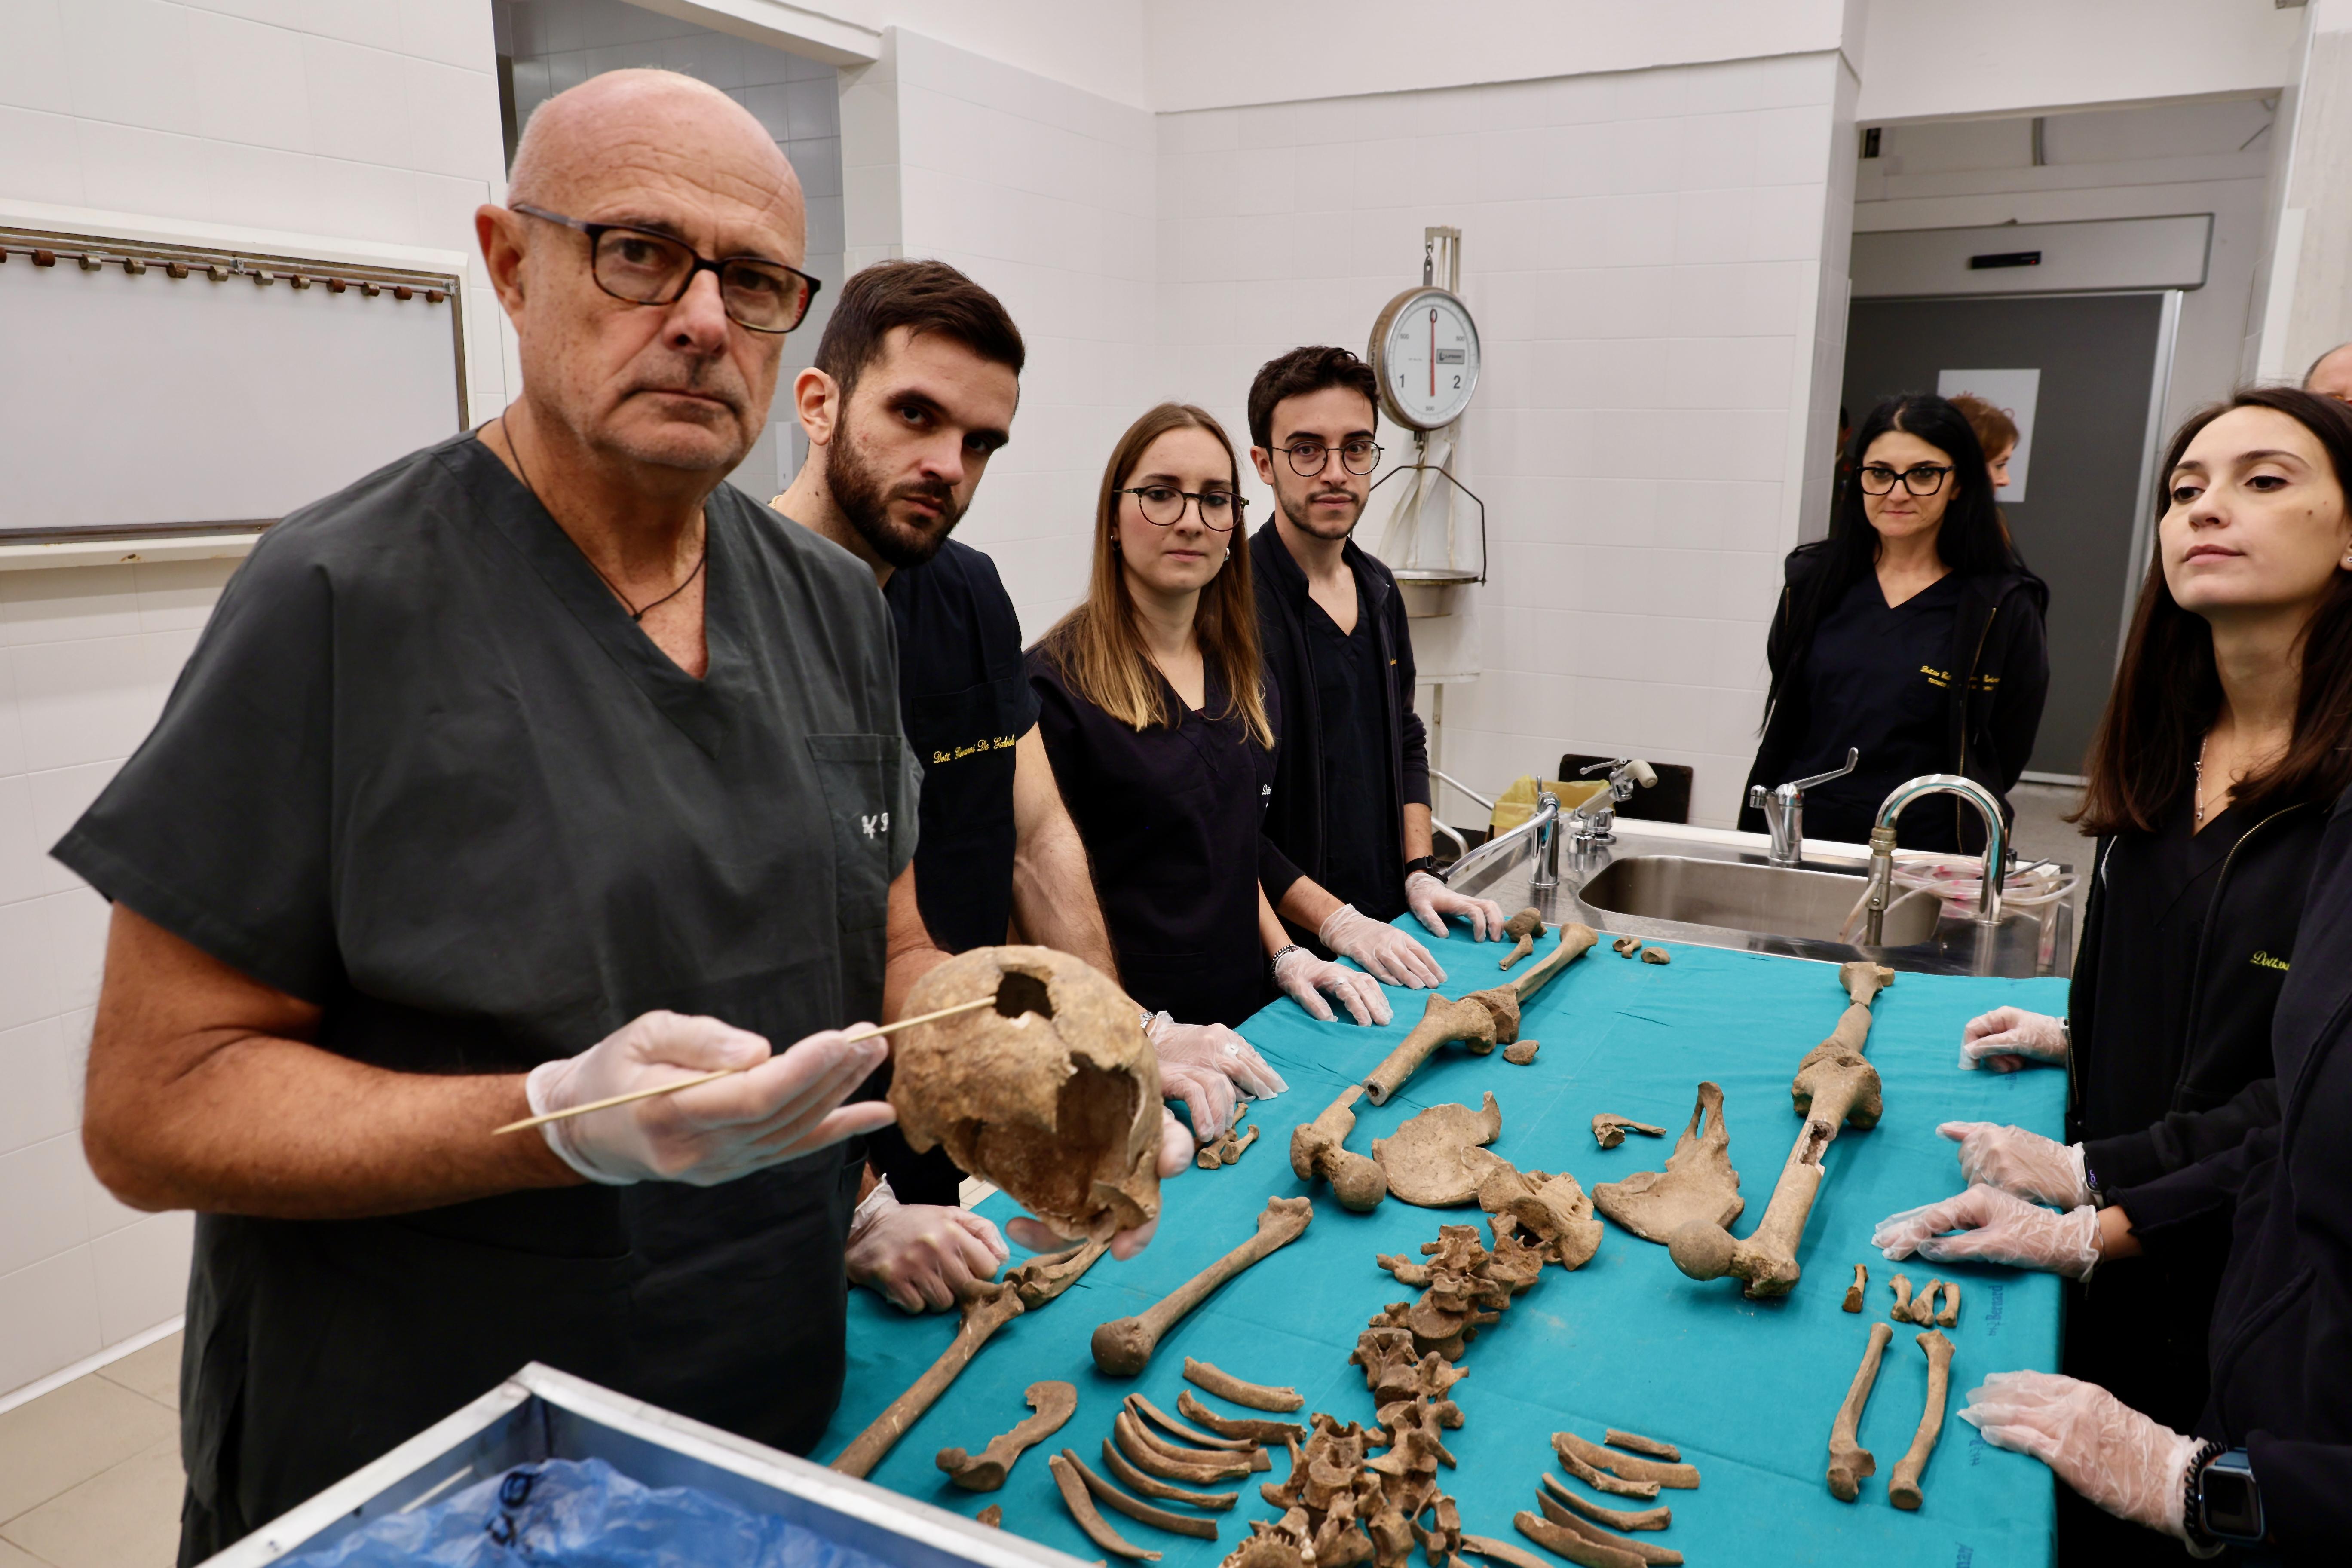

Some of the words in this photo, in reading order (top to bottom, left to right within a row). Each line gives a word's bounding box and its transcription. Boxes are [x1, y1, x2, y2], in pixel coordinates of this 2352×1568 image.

[1430, 309, 1438, 323] 0
[1399, 374, 1405, 388] 1
[1453, 375, 1461, 389] 2
